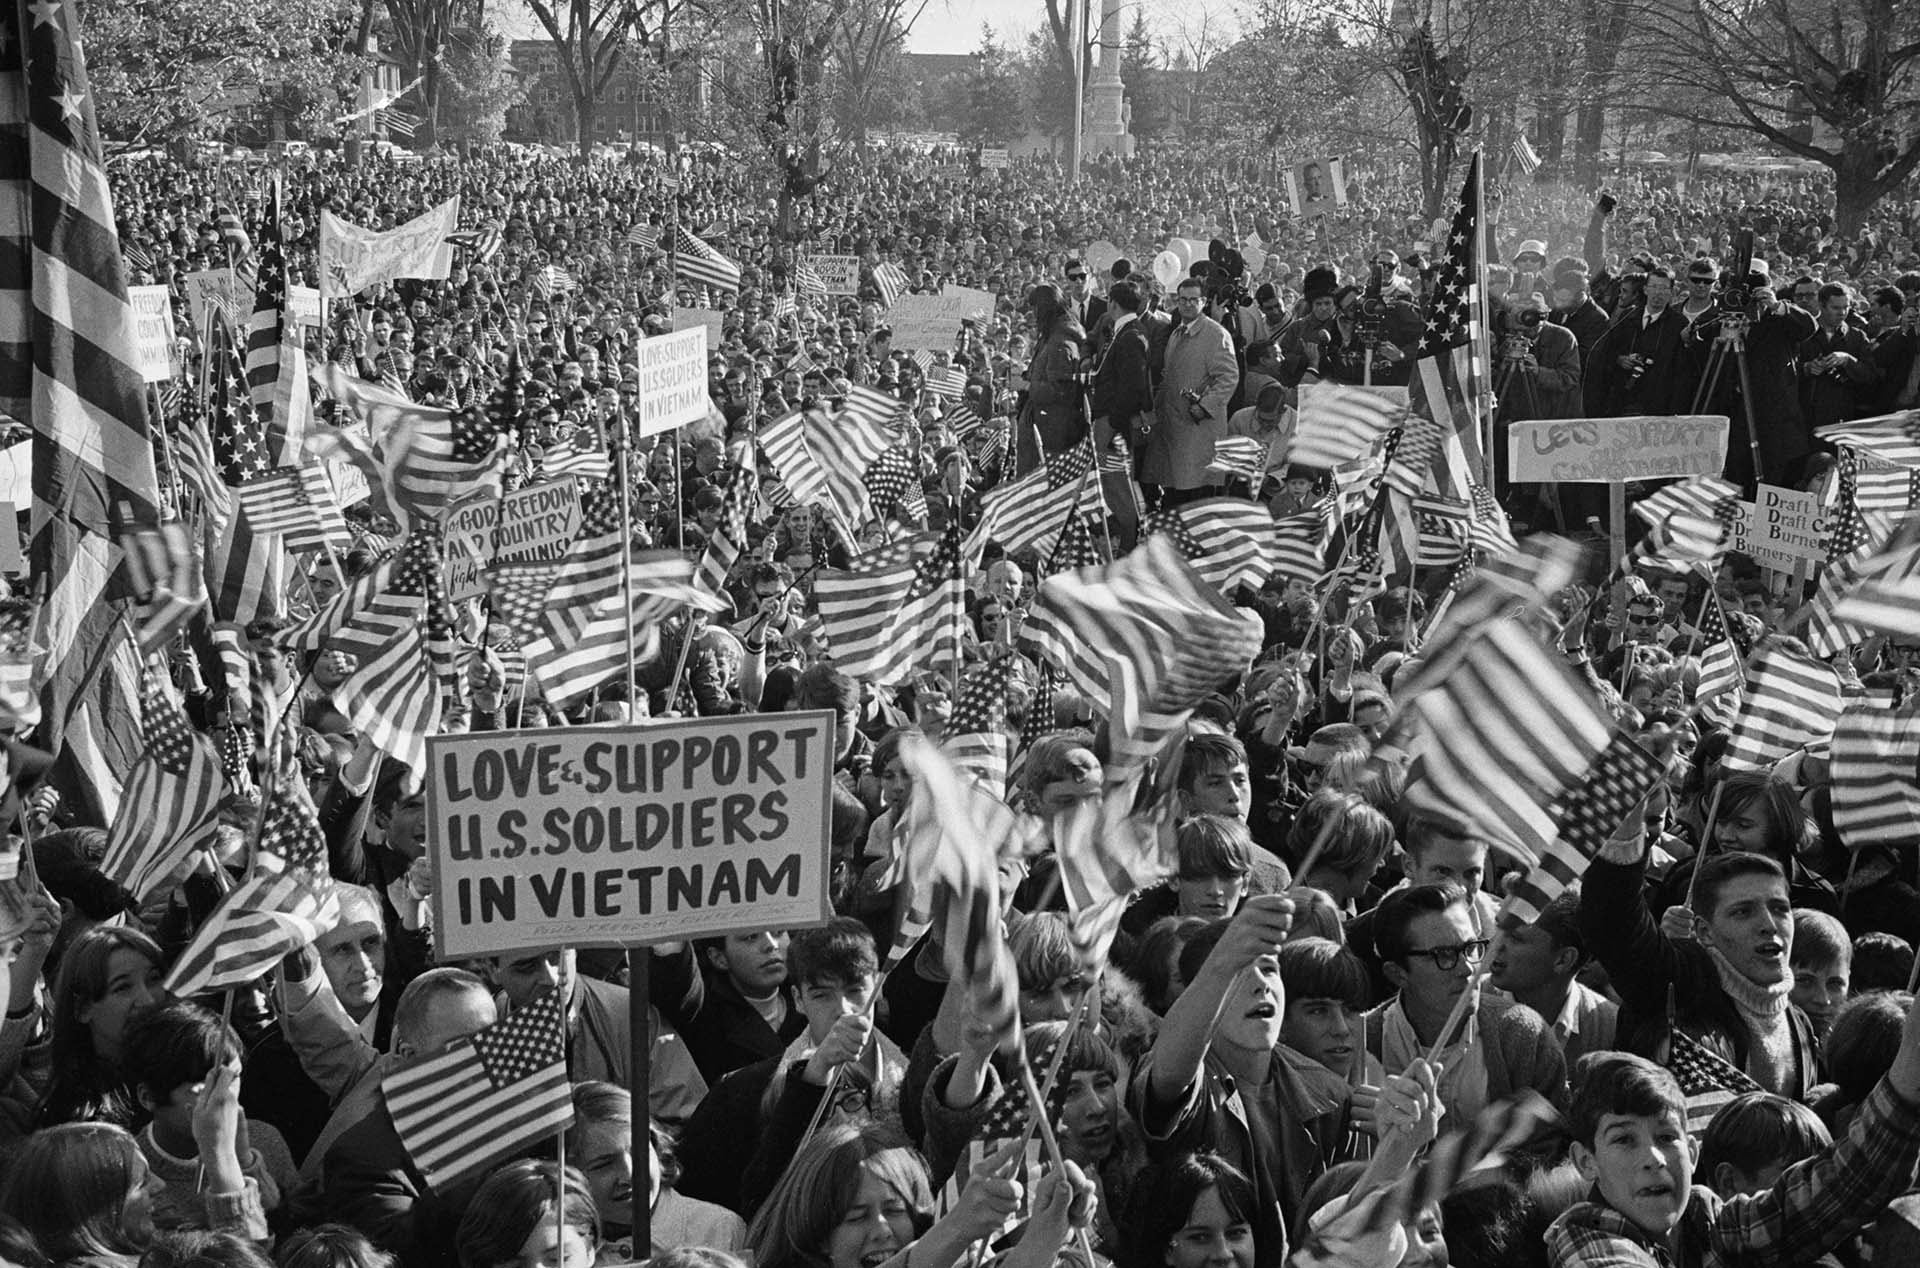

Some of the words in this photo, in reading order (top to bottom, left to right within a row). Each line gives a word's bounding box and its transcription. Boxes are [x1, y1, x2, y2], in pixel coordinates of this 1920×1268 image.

[665, 335, 702, 362] SUPPORT
[645, 399, 655, 420] IN
[656, 386, 702, 416] VIETNAM
[1766, 491, 1810, 514] Draft
[1768, 508, 1806, 530] Draft
[490, 505, 572, 549] COUNTRY
[1735, 537, 1793, 563] Burners
[443, 742, 562, 803] LOVE
[582, 726, 818, 794] SUPPORT
[542, 790, 790, 857] SOLDIERS
[457, 874, 516, 926] IN
[529, 853, 802, 919] VIETNAM
